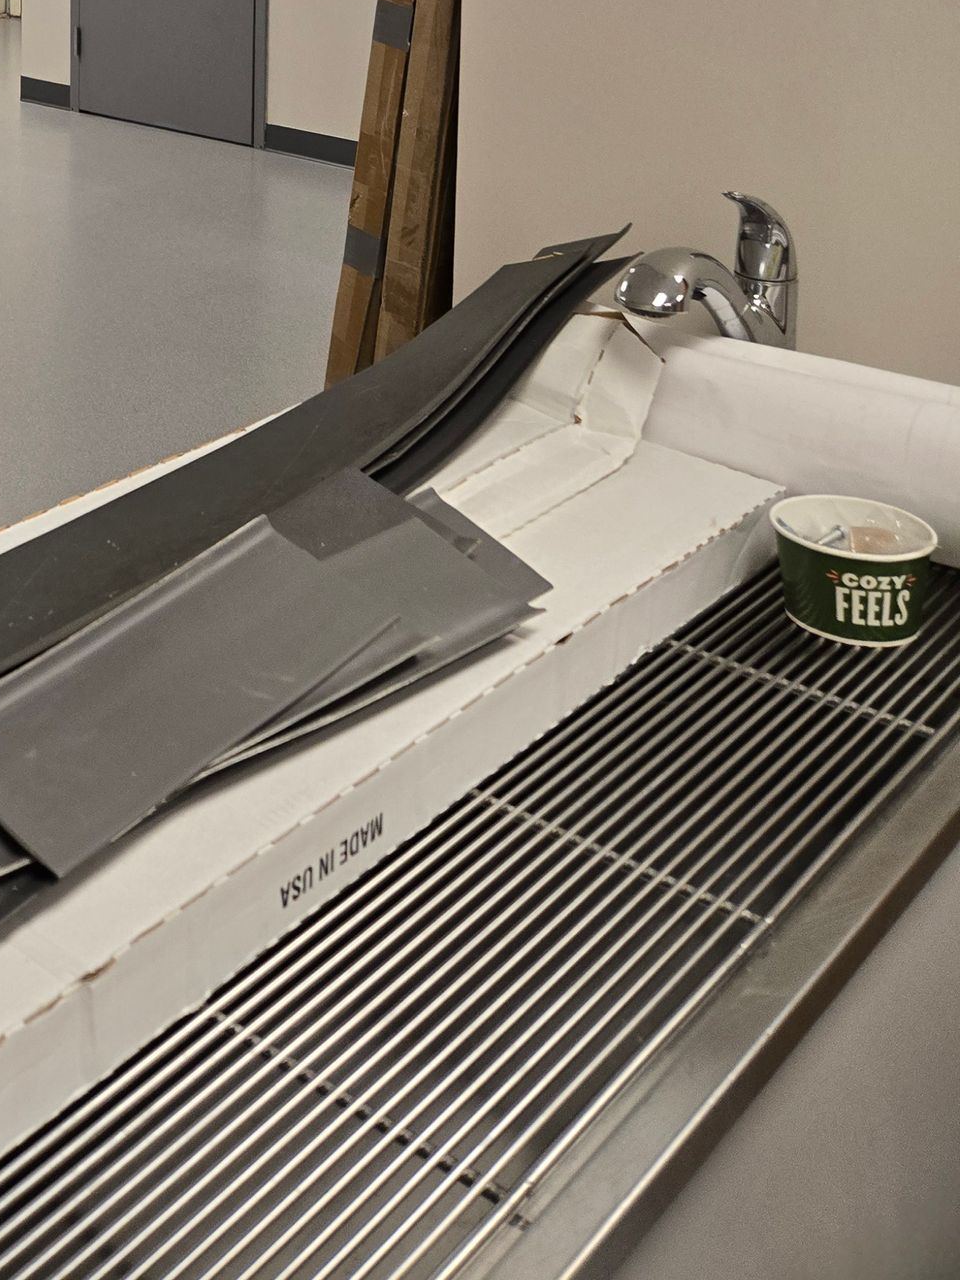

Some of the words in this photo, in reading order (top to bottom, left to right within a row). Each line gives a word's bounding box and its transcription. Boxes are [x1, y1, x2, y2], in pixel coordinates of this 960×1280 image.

[842, 573, 906, 590] COZY
[835, 587, 910, 626] FEELS
[339, 812, 383, 865] MADE
[319, 848, 335, 881] IN
[280, 866, 313, 908] USA
